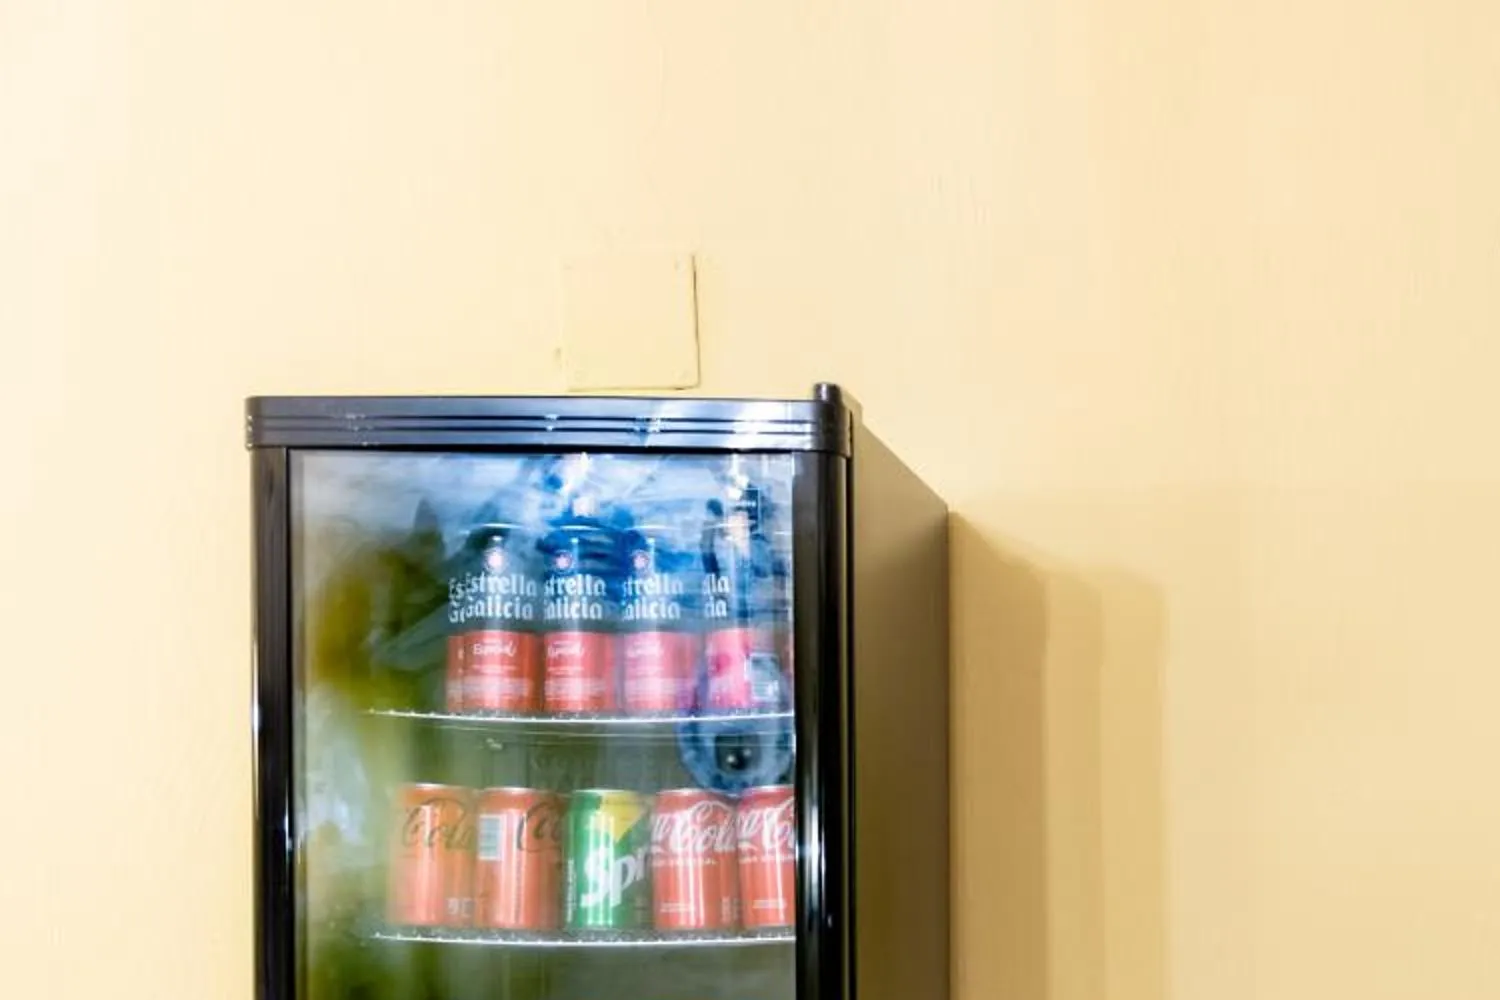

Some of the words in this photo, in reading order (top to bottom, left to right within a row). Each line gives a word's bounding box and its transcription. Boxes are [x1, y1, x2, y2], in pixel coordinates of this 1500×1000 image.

[544, 573, 606, 596] strella
[544, 596, 602, 620] alicia
[622, 596, 681, 621] alicia
[579, 843, 647, 909] Spr
